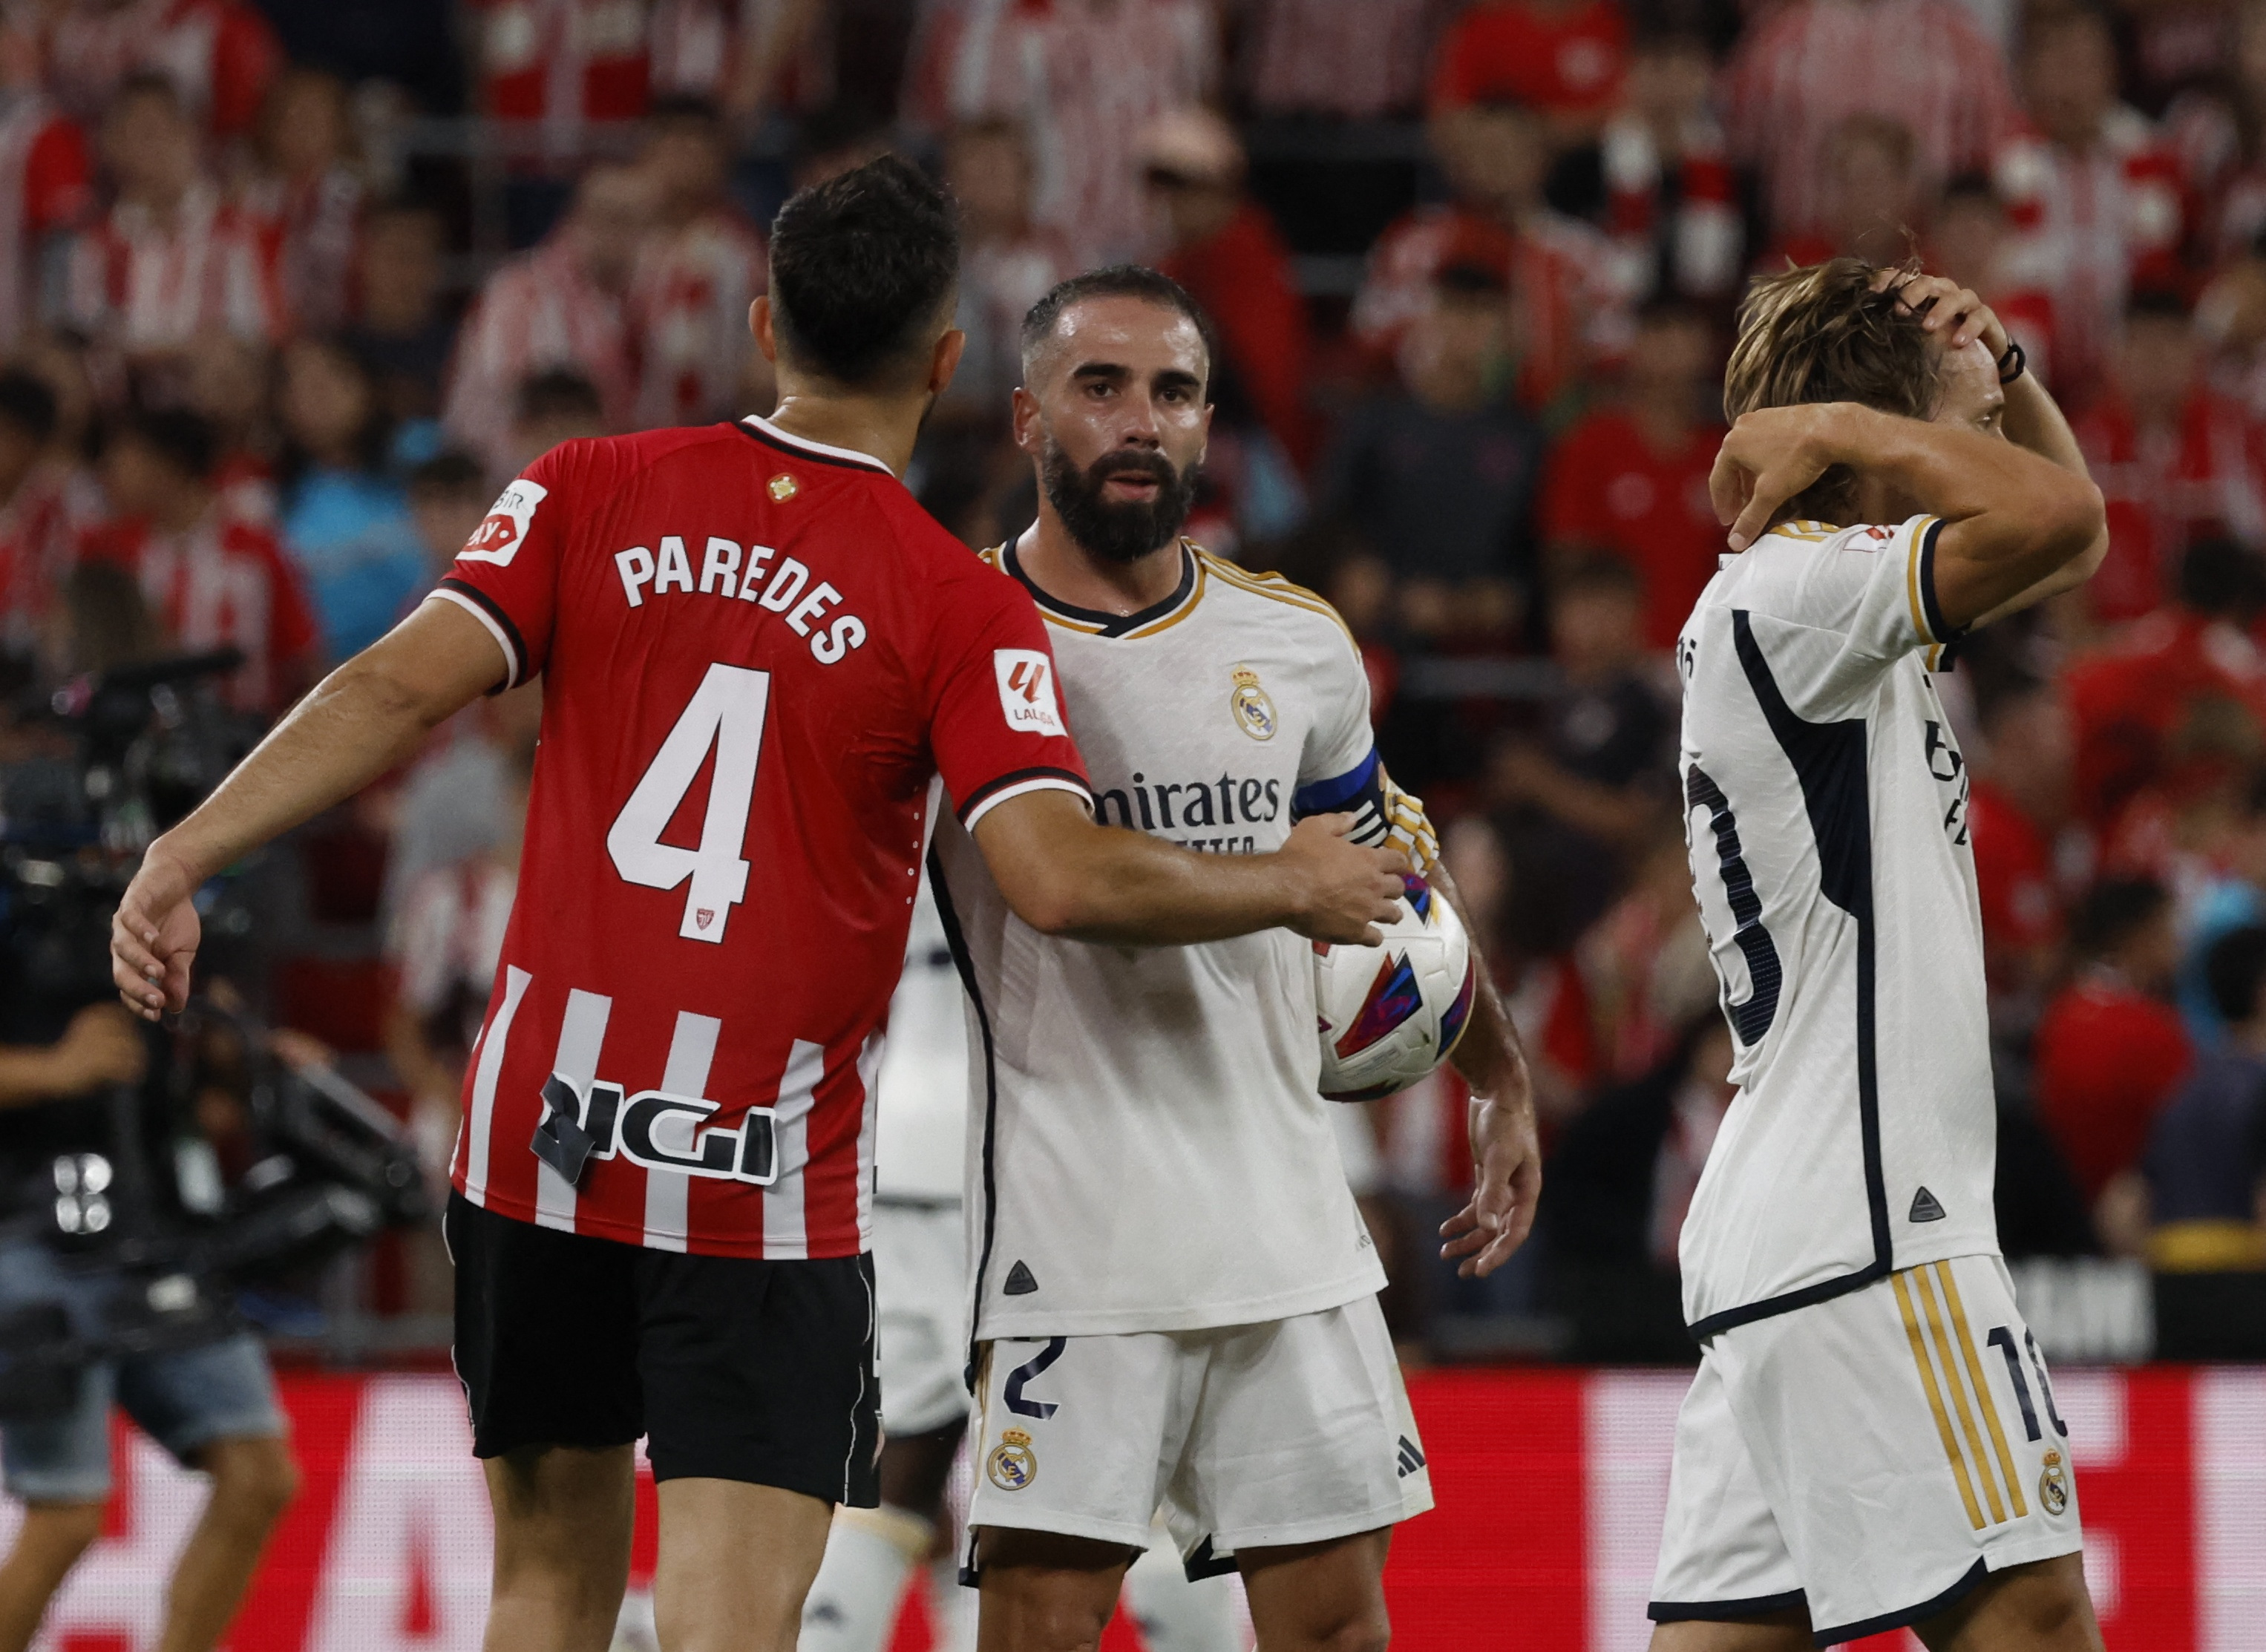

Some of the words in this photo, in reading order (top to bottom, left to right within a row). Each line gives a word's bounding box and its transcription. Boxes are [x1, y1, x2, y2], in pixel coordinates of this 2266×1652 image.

[615, 535, 867, 665] PAREDES
[606, 662, 770, 944] 4
[1093, 771, 1280, 830] mirates
[1003, 1337, 1067, 1420] 2
